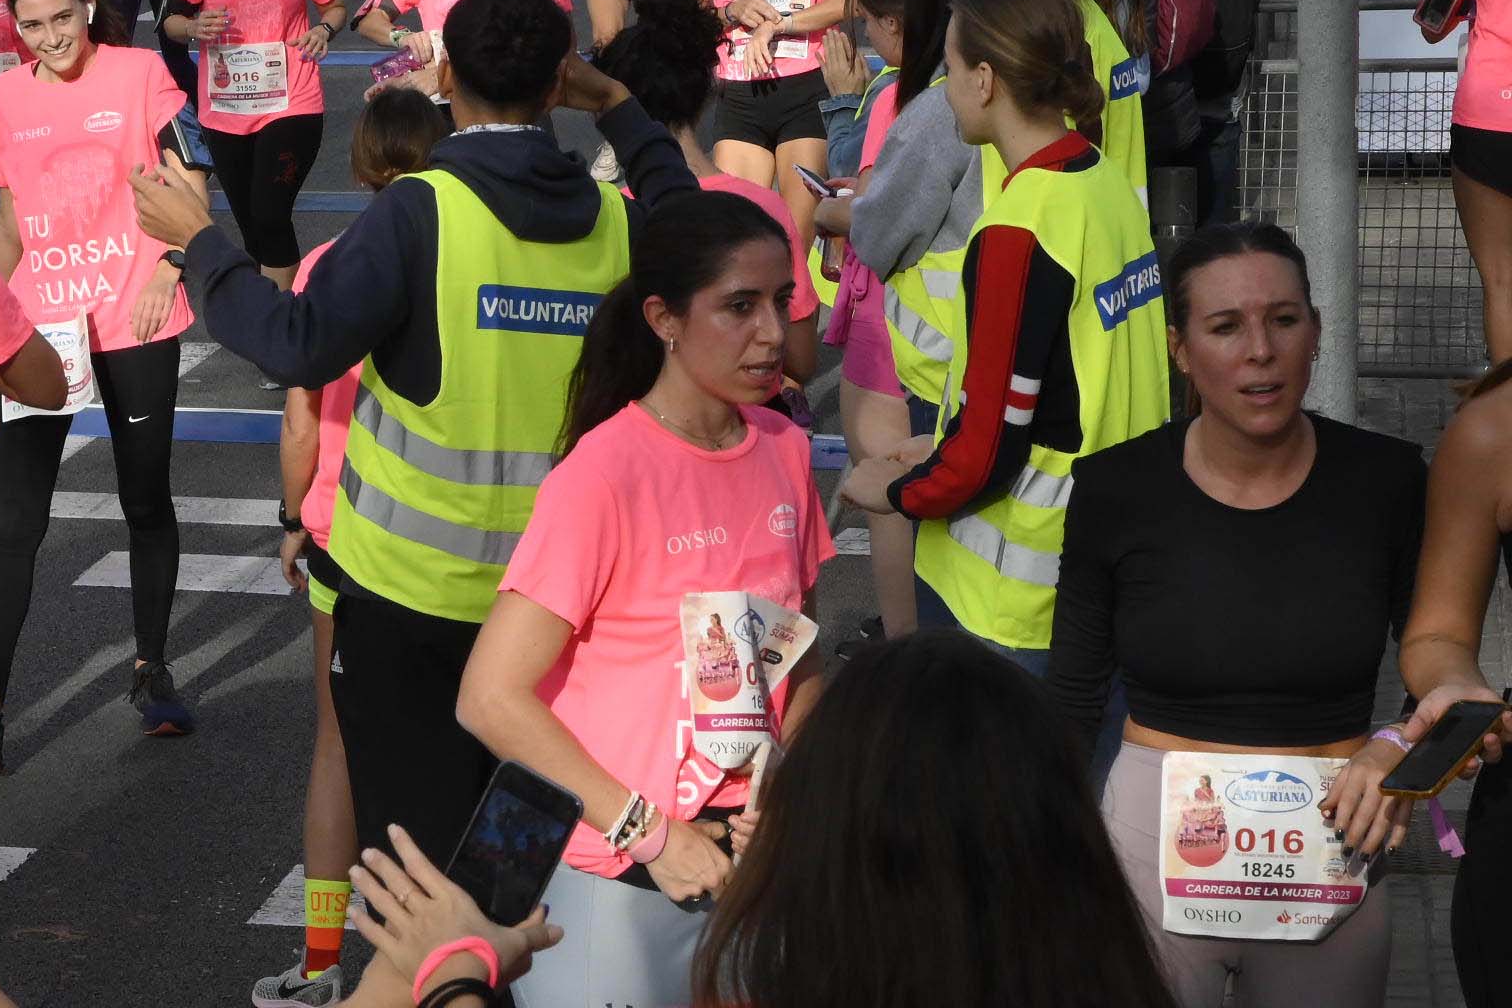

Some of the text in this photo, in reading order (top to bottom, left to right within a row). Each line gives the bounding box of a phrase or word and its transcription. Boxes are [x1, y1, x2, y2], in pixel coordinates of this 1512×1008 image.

[232, 71, 260, 82] 016
[24, 214, 50, 238] TU
[30, 232, 135, 273] DORSAL
[37, 273, 113, 305] SUMA
[481, 296, 594, 325] VOLUNTARI
[667, 526, 727, 555] OYSHO
[769, 627, 795, 644] SUMA
[711, 717, 764, 728] CARRERA DE
[1232, 785, 1307, 803] ASTURIANA
[1235, 828, 1305, 854] 016
[1241, 862, 1295, 878] 18245
[1185, 883, 1352, 900] CARRERA DE LA MUJER 2023
[1184, 907, 1242, 924] OYSHO
